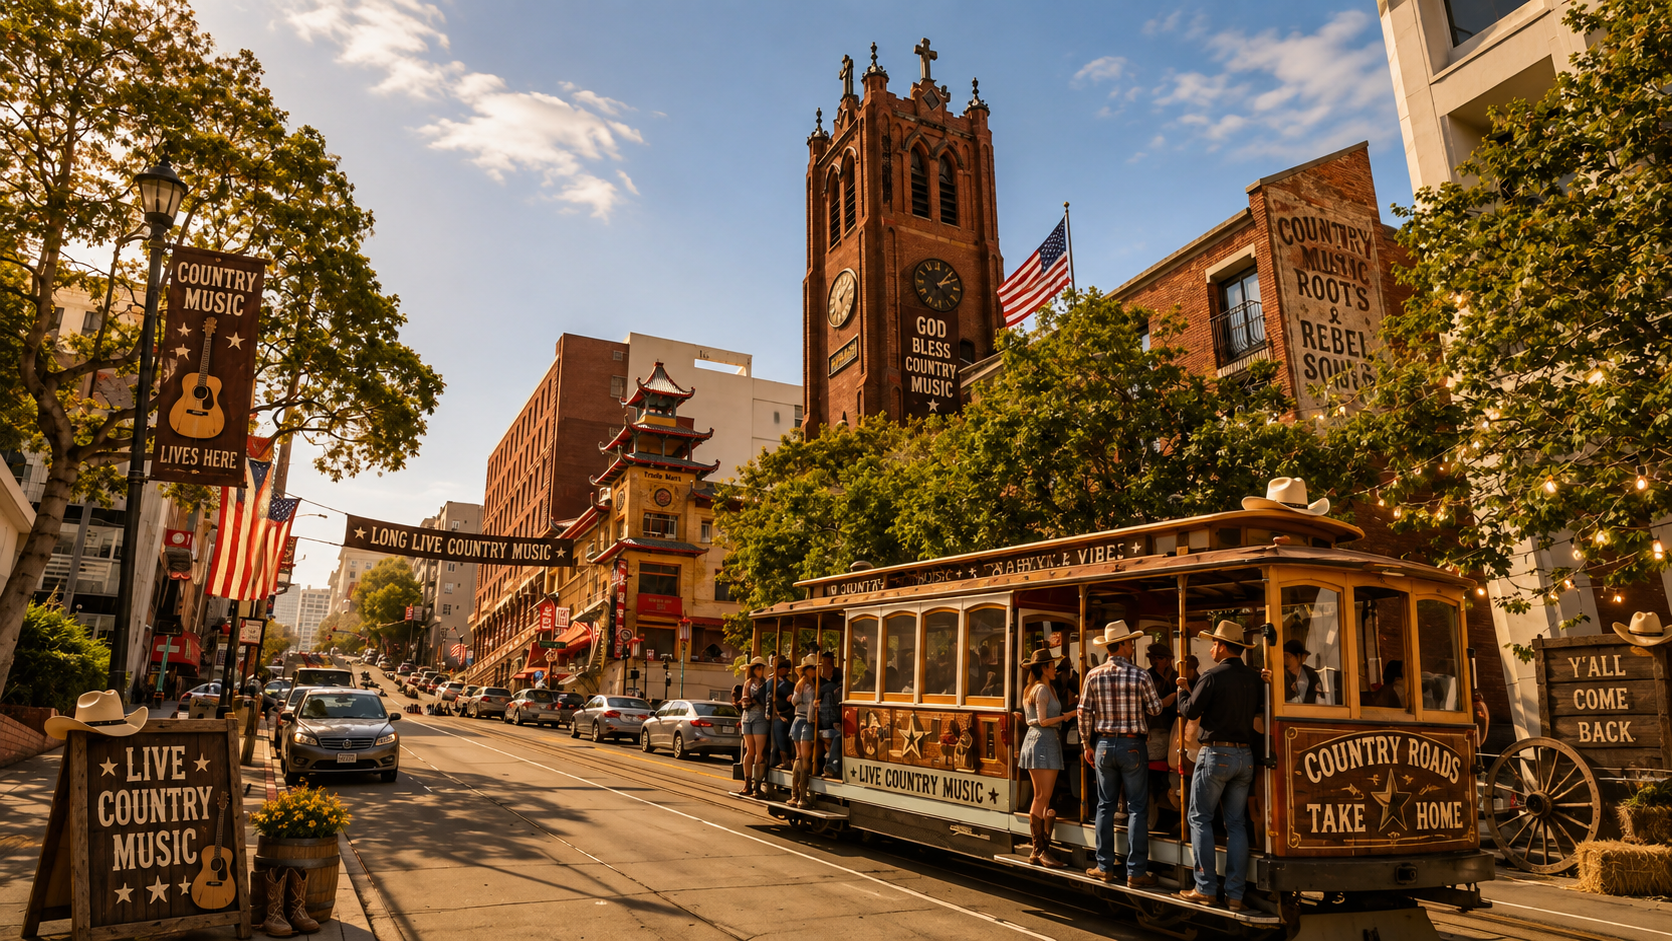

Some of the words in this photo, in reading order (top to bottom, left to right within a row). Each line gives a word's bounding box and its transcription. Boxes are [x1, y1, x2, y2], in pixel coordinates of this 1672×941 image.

[1277, 216, 1372, 260] COUNTRY
[177, 261, 258, 293] COUNTRY
[183, 286, 245, 317] MUSIC
[915, 315, 947, 338] GOD
[1300, 319, 1369, 359] REBEL
[911, 336, 951, 359] BLESS
[905, 356, 957, 380] COUNTRY
[910, 375, 954, 398] MUSIC
[160, 444, 199, 466] LIVES
[203, 447, 238, 470] HERE
[370, 525, 408, 549] LONG
[411, 533, 443, 554] LIVE
[447, 537, 508, 559] COUNTRY
[511, 543, 552, 561] MUSIC
[1077, 542, 1125, 565] VIBES
[1567, 654, 1627, 678] Y'ALL
[1573, 687, 1629, 710] COME
[125, 745, 187, 782] LIVE
[1304, 735, 1402, 784] COUNTRY
[1407, 737, 1461, 784] ROADS
[859, 764, 882, 786] LIVE
[885, 768, 938, 796] COUNTRY
[942, 776, 984, 804] MUSIC
[97, 785, 214, 828] COUNTRY
[1306, 803, 1367, 833] TAKE
[1415, 801, 1464, 830] HOME
[112, 827, 198, 872] MUSIC
